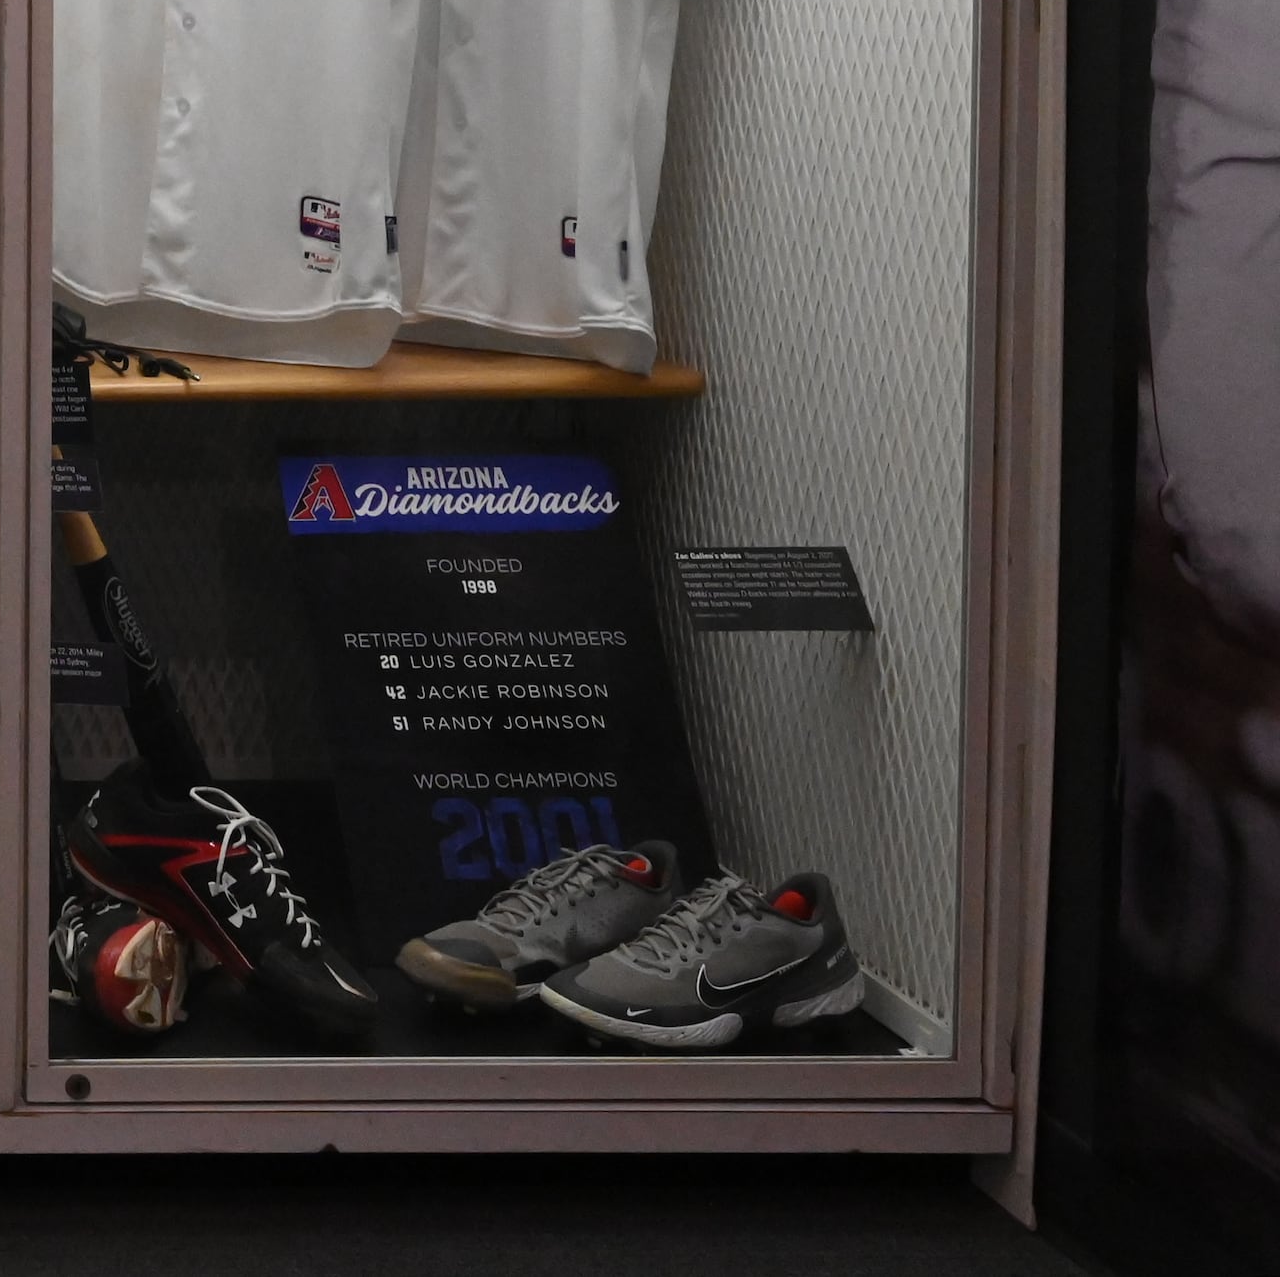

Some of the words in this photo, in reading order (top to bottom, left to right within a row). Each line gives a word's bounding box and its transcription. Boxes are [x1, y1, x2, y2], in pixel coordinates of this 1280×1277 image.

[407, 467, 508, 490] ARIZONA
[354, 483, 620, 517] Diamondbacks
[426, 558, 523, 573] FOUNDED
[462, 580, 497, 594] 1998
[110, 585, 150, 656] Slugger
[344, 632, 427, 648] RETIRED
[433, 631, 524, 647] UNIFORM
[529, 631, 627, 647] NUMBERS
[380, 655, 399, 669] 20
[410, 655, 455, 669] LUIS
[463, 654, 575, 668] GONZALEZ
[385, 685, 406, 699] 42
[416, 685, 490, 700] JACKIE
[498, 684, 608, 699] ROBINSON
[392, 717, 409, 731] 51
[422, 716, 493, 730] RANDY
[503, 715, 606, 730] JOHNSON
[413, 773, 490, 789] WORLD
[494, 772, 618, 789] CHAMPIONS
